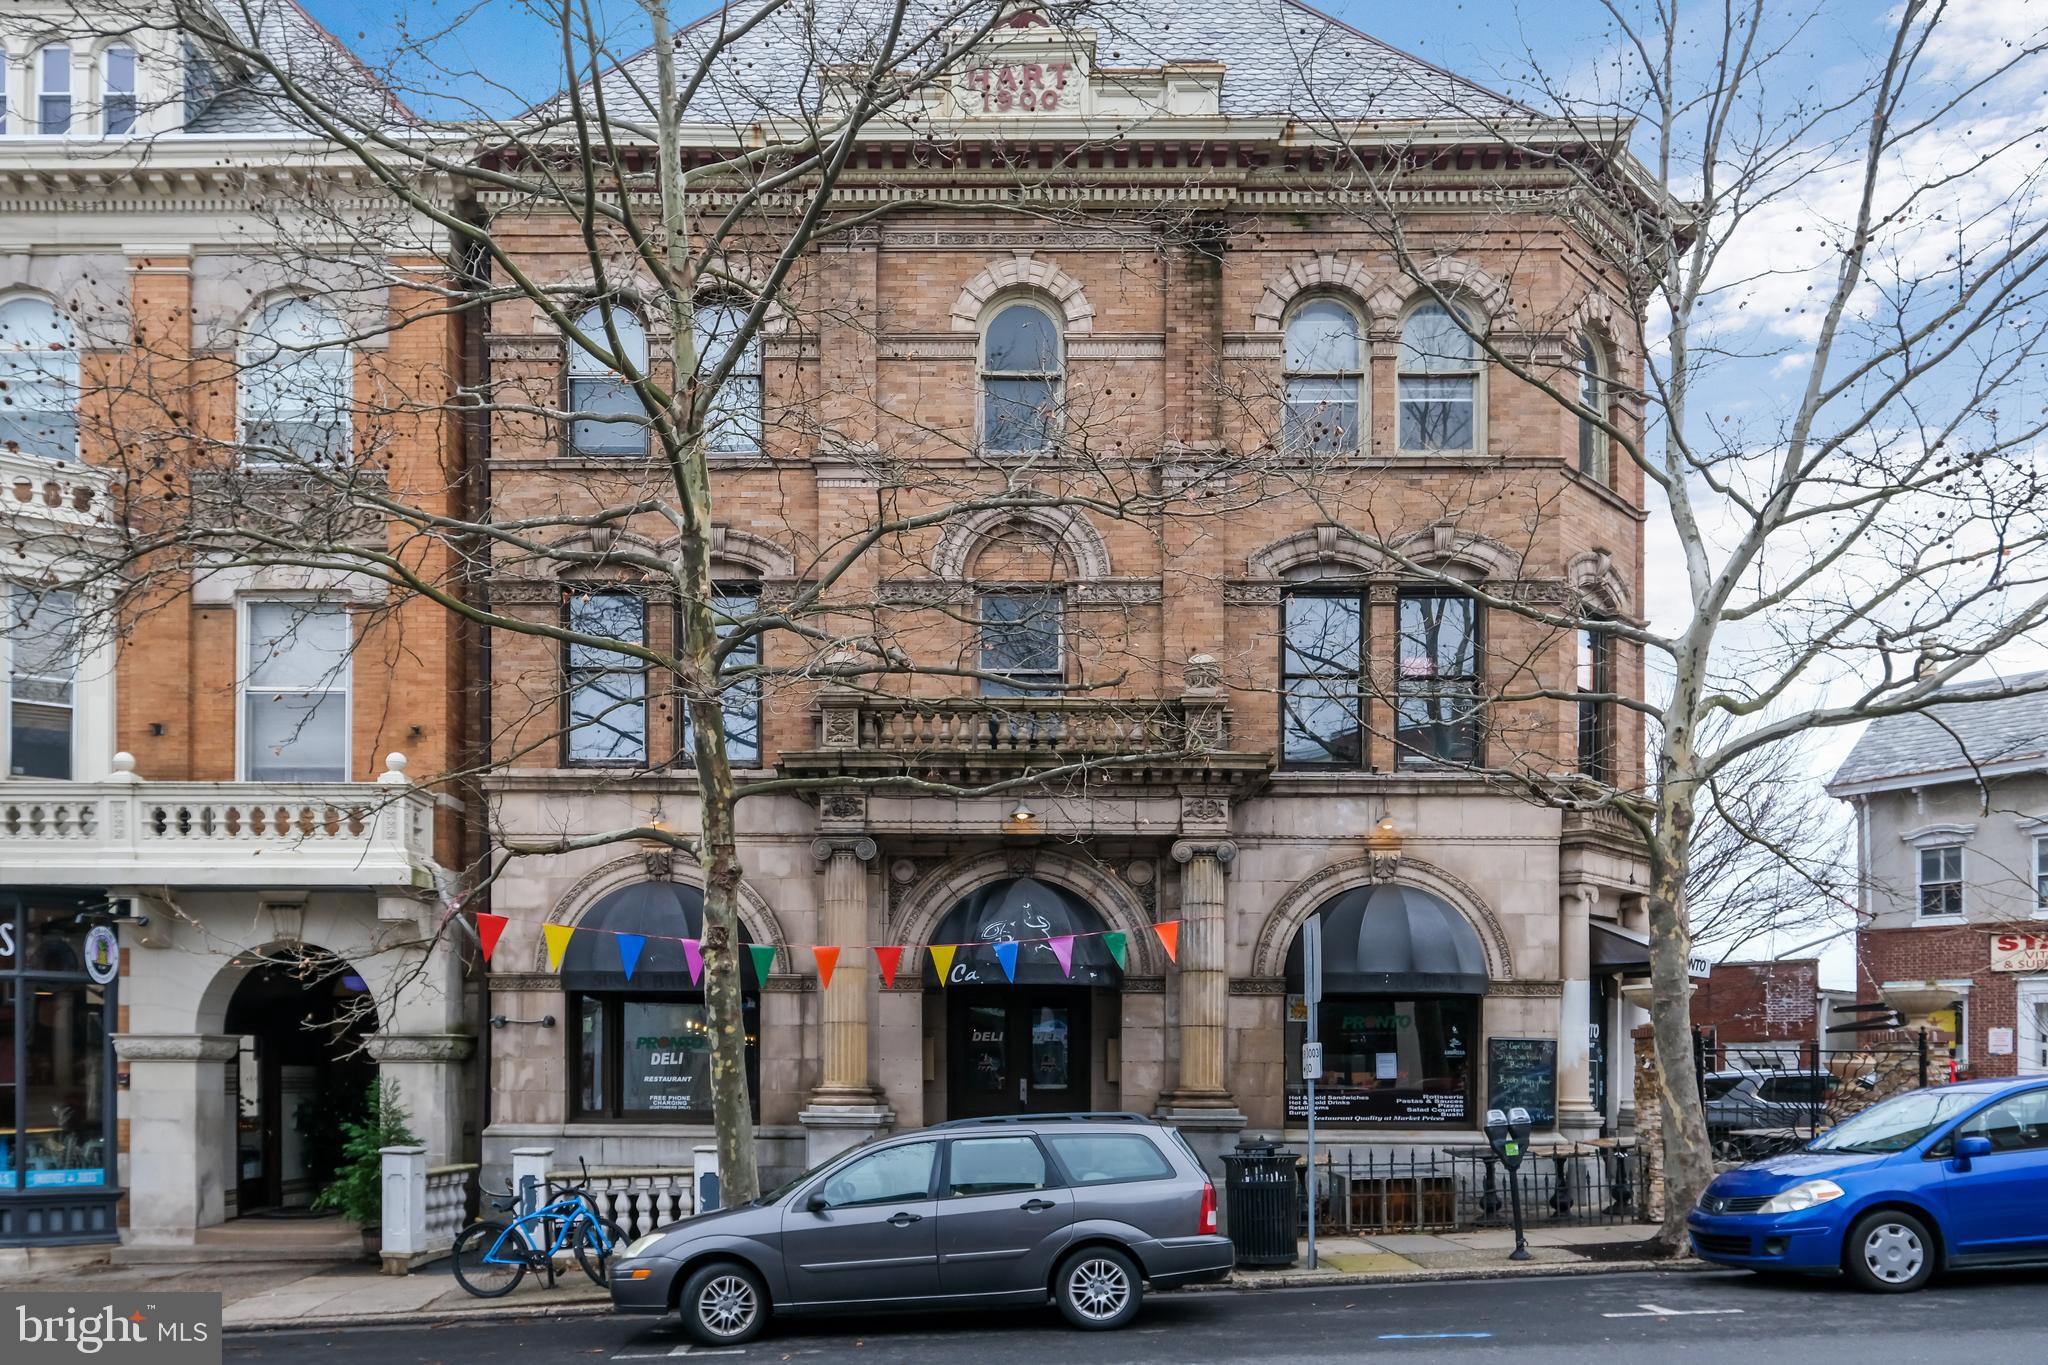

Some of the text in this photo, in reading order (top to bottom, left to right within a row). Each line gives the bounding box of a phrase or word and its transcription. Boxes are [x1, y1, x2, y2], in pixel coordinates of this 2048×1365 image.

[966, 64, 1072, 90] HART
[982, 89, 1059, 112] 1900
[2004, 961, 2013, 969] &
[972, 1031, 1004, 1042] DELI
[650, 1052, 684, 1066] DELI
